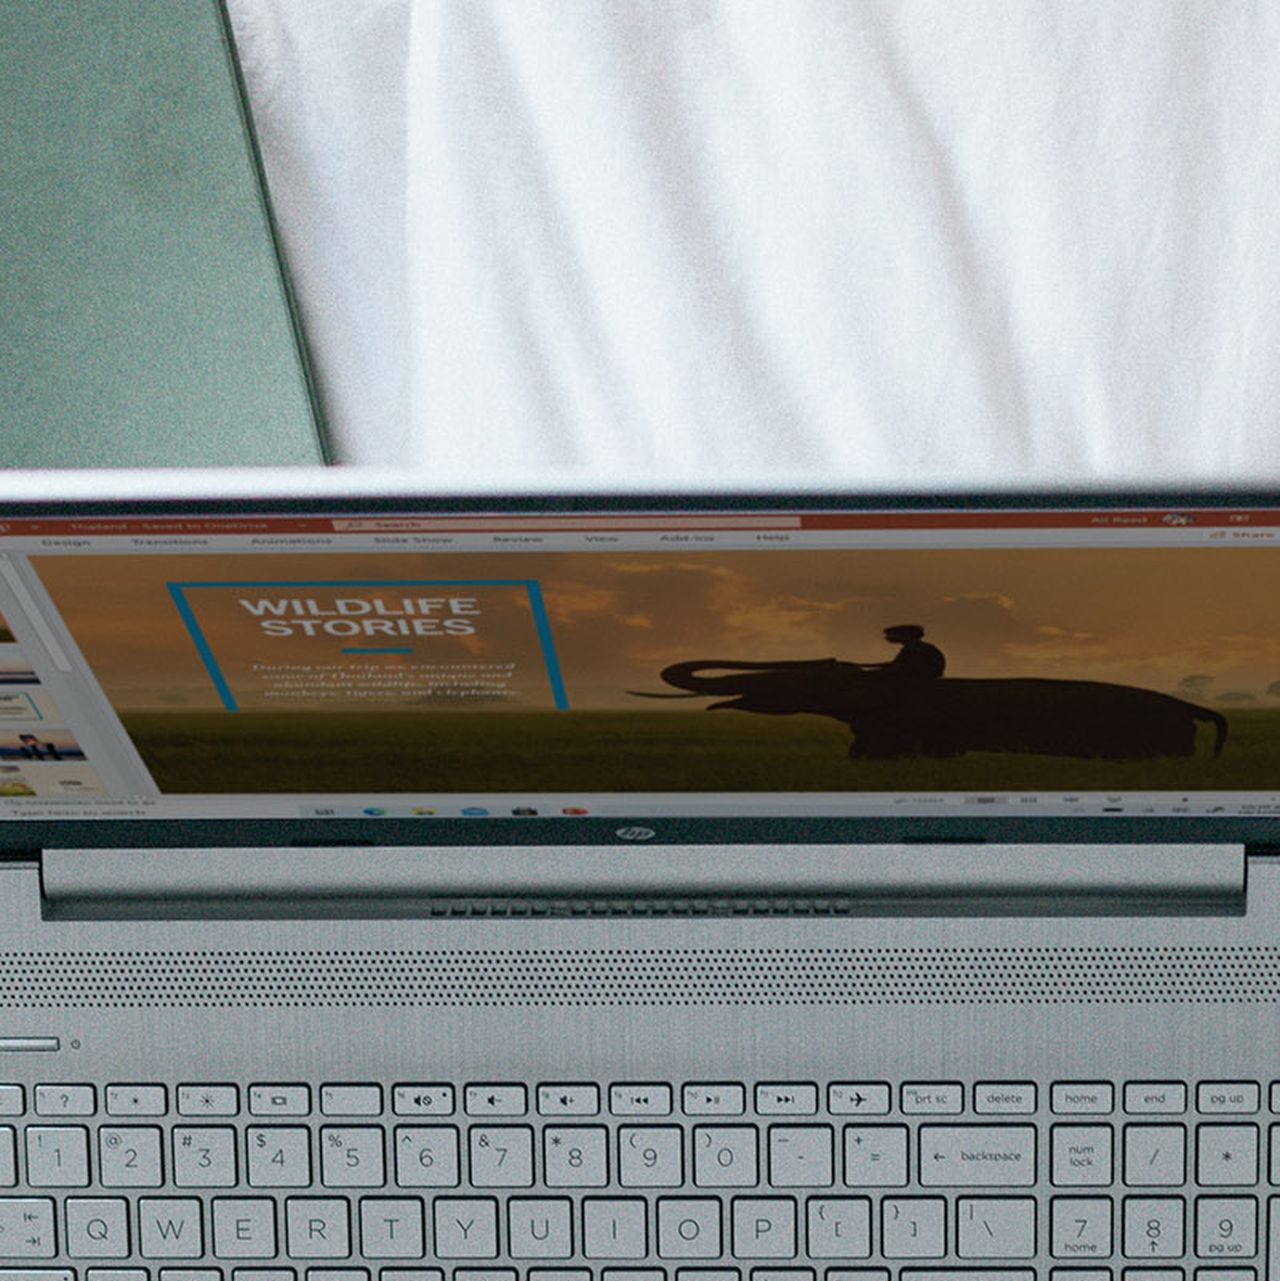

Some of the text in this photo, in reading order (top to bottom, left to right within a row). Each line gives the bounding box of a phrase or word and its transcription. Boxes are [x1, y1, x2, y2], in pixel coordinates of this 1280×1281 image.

[41, 538, 92, 547] Design
[131, 537, 208, 546] Transitions
[251, 537, 332, 545] Animations
[238, 597, 481, 616] WILDLIFE
[260, 618, 476, 637] STORIES
[987, 1094, 1022, 1103] delete
[961, 1150, 1022, 1162] backspace
[86, 1218, 109, 1241] Q
[156, 1219, 185, 1240] W
[235, 1218, 252, 1241] E
[308, 1218, 327, 1240] R
[383, 1218, 400, 1240] T
[455, 1218, 475, 1240] Y
[530, 1218, 550, 1241] U
[677, 1218, 701, 1241] O
[755, 1218, 773, 1240] P
